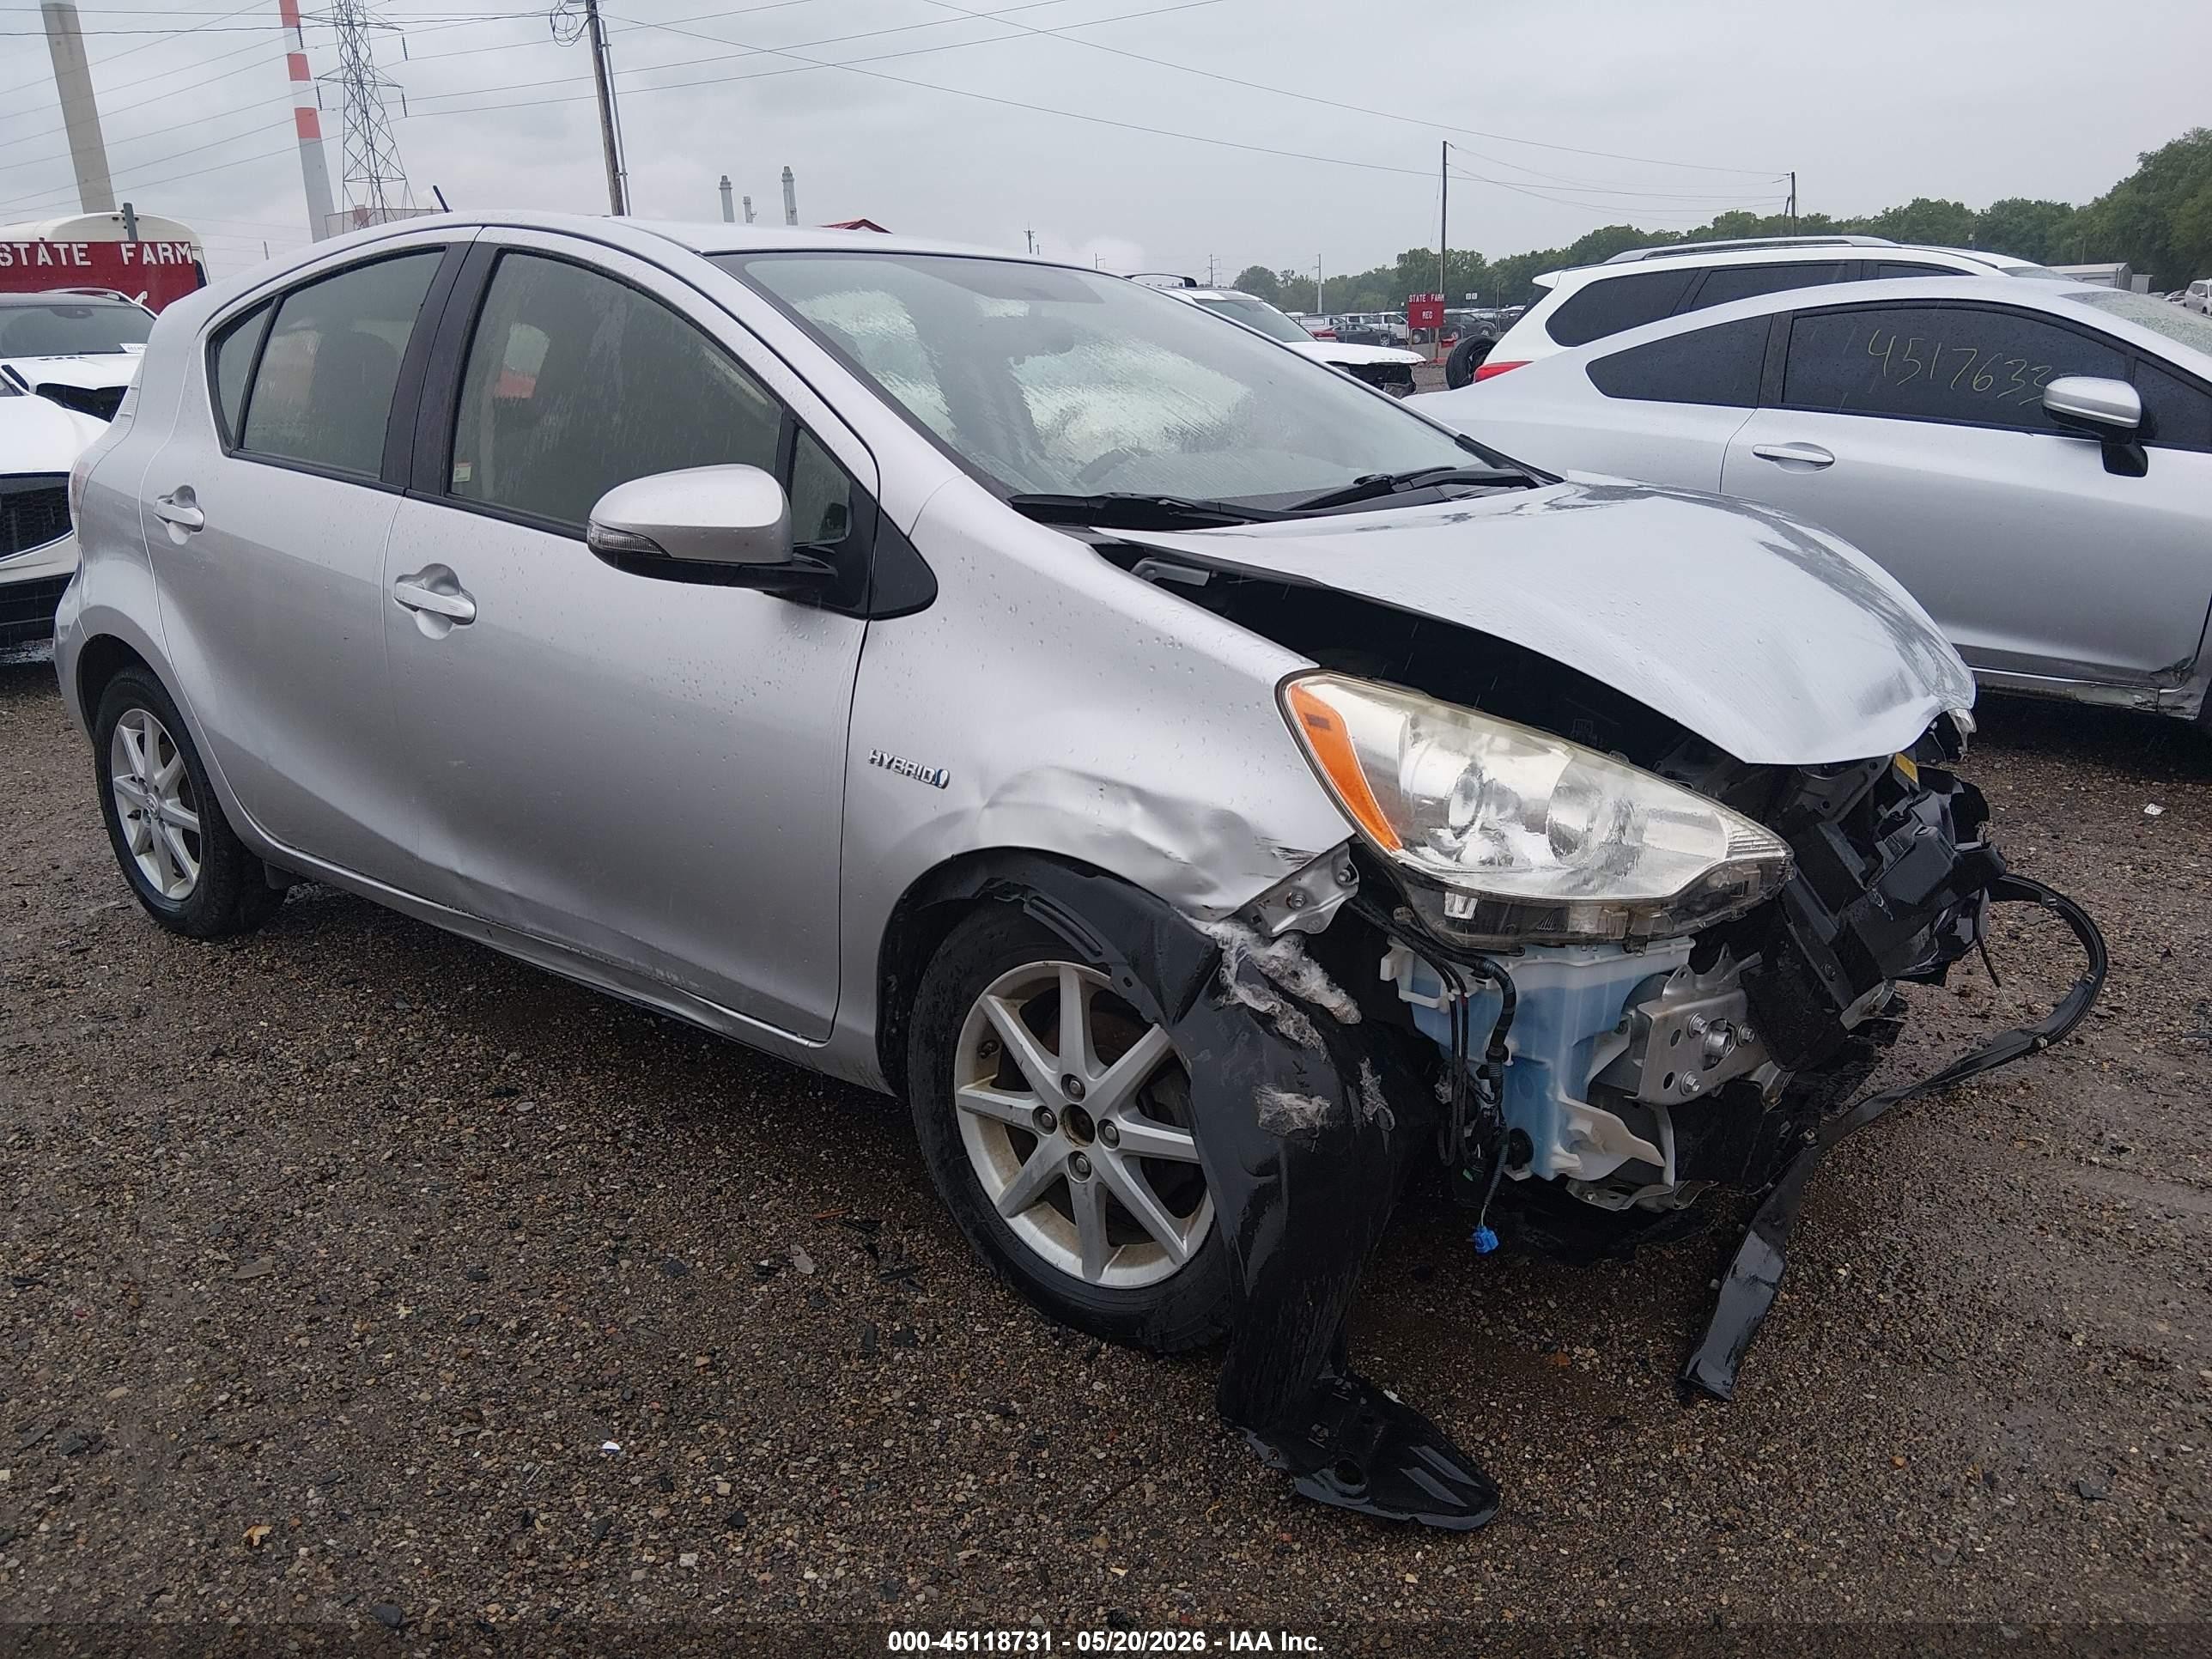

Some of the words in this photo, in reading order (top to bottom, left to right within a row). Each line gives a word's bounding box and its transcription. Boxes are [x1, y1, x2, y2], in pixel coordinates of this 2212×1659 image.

[0, 243, 92, 266] STATE
[120, 243, 194, 265] FARM
[1408, 294, 1426, 303] STATE
[1431, 293, 1445, 302] FARM
[868, 748, 936, 784] HYBRID
